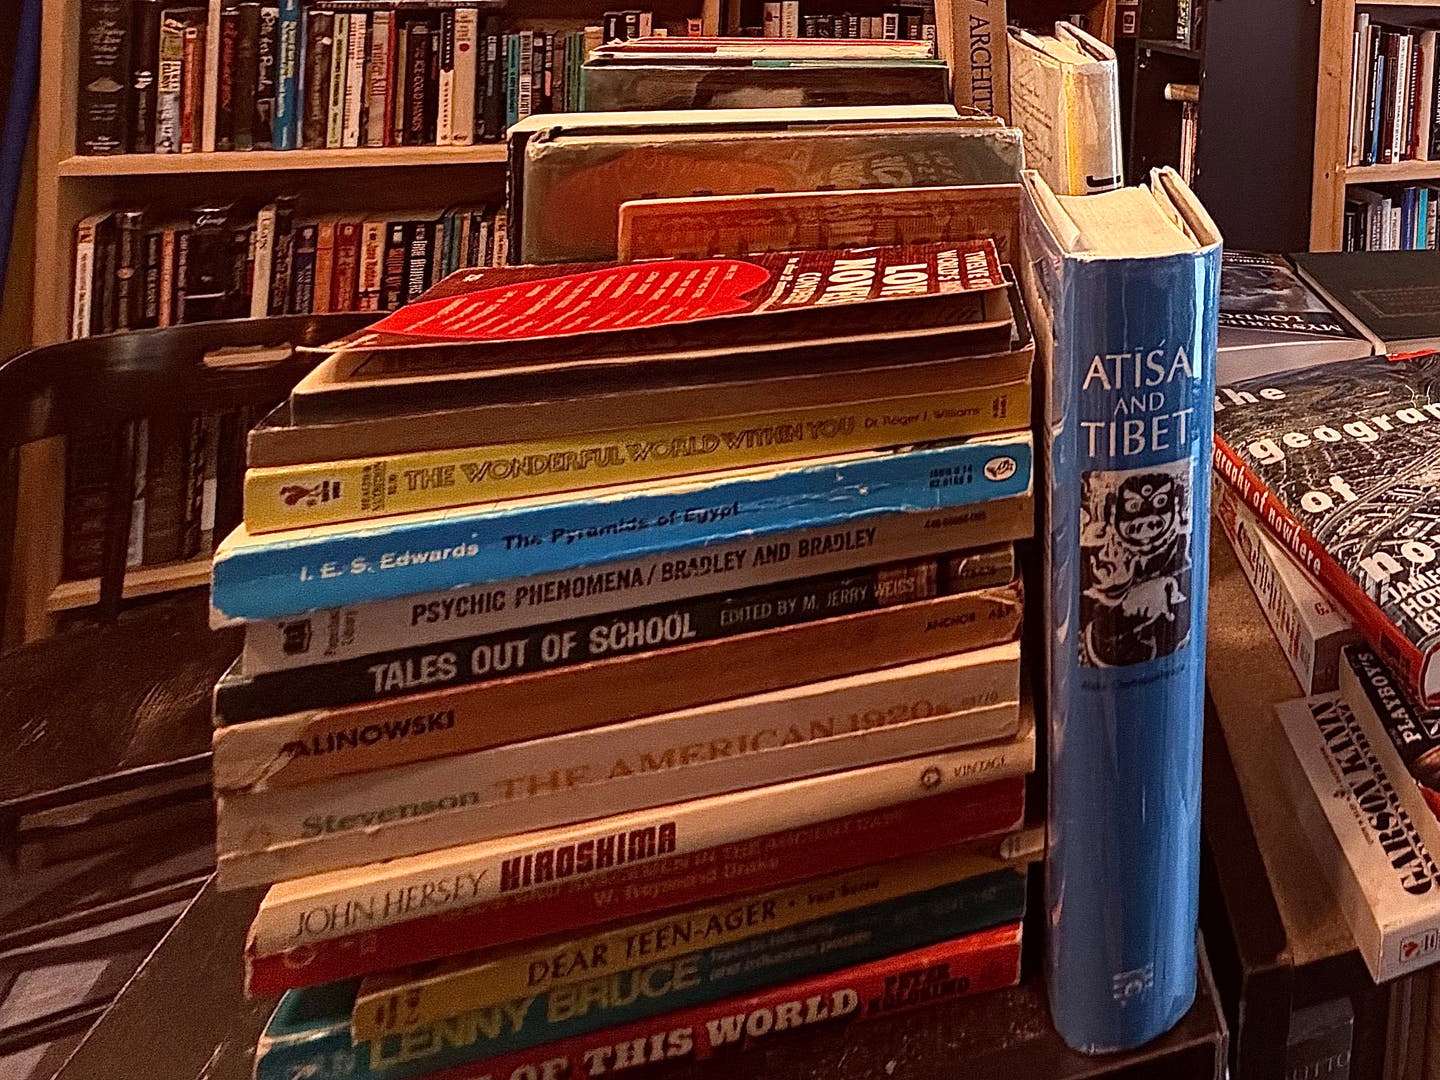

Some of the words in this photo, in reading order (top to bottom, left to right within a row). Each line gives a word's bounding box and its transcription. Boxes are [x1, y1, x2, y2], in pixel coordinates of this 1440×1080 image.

[408, 259, 426, 294] BELIEVERS
[1080, 407, 1194, 458] TIBET
[1114, 392, 1165, 417] AND
[403, 464, 457, 492] THE
[459, 444, 625, 484] WONDERFUL
[624, 435, 720, 464] WORLD
[722, 423, 805, 451] WITHIN
[807, 415, 857, 440] YOU
[1301, 475, 1360, 515] of
[320, 562, 344, 580] E.
[351, 556, 372, 574] S.
[380, 541, 480, 571] Edwards
[503, 531, 542, 552] The
[550, 516, 656, 546] Pyramids
[660, 507, 678, 526] of
[683, 500, 741, 526] Egypt
[409, 589, 507, 627] PSYCHIC
[514, 568, 646, 609] PHENOMENA
[661, 550, 745, 582] BRADLEY
[754, 541, 791, 565] AND
[799, 527, 878, 560] BRADLEY
[368, 650, 458, 694] TALES
[471, 638, 527, 675] OUT
[541, 629, 578, 659] OF
[588, 612, 698, 654] SCHOOL
[719, 602, 772, 628] EDITED
[776, 598, 798, 617] BY
[802, 592, 820, 612] M.
[827, 584, 868, 609] JERRY
[874, 575, 917, 600] WEISS
[1357, 649, 1423, 744] PLAYBOY'S
[299, 790, 481, 839] Stevenson
[495, 766, 591, 802] THE
[608, 716, 836, 778] AMERICAN
[290, 899, 376, 942] JOHN
[382, 869, 489, 923] HERSEY
[501, 821, 677, 891] HIROSHIMA
[952, 754, 1008, 780] VINTAGE
[526, 945, 610, 987] DEAR
[625, 899, 777, 960] TEEN-AGER
[367, 993, 536, 1071] LENNY
[546, 955, 702, 1024] BRUCE
[582, 1023, 695, 1080] THIS
[706, 985, 859, 1048] WORLD
